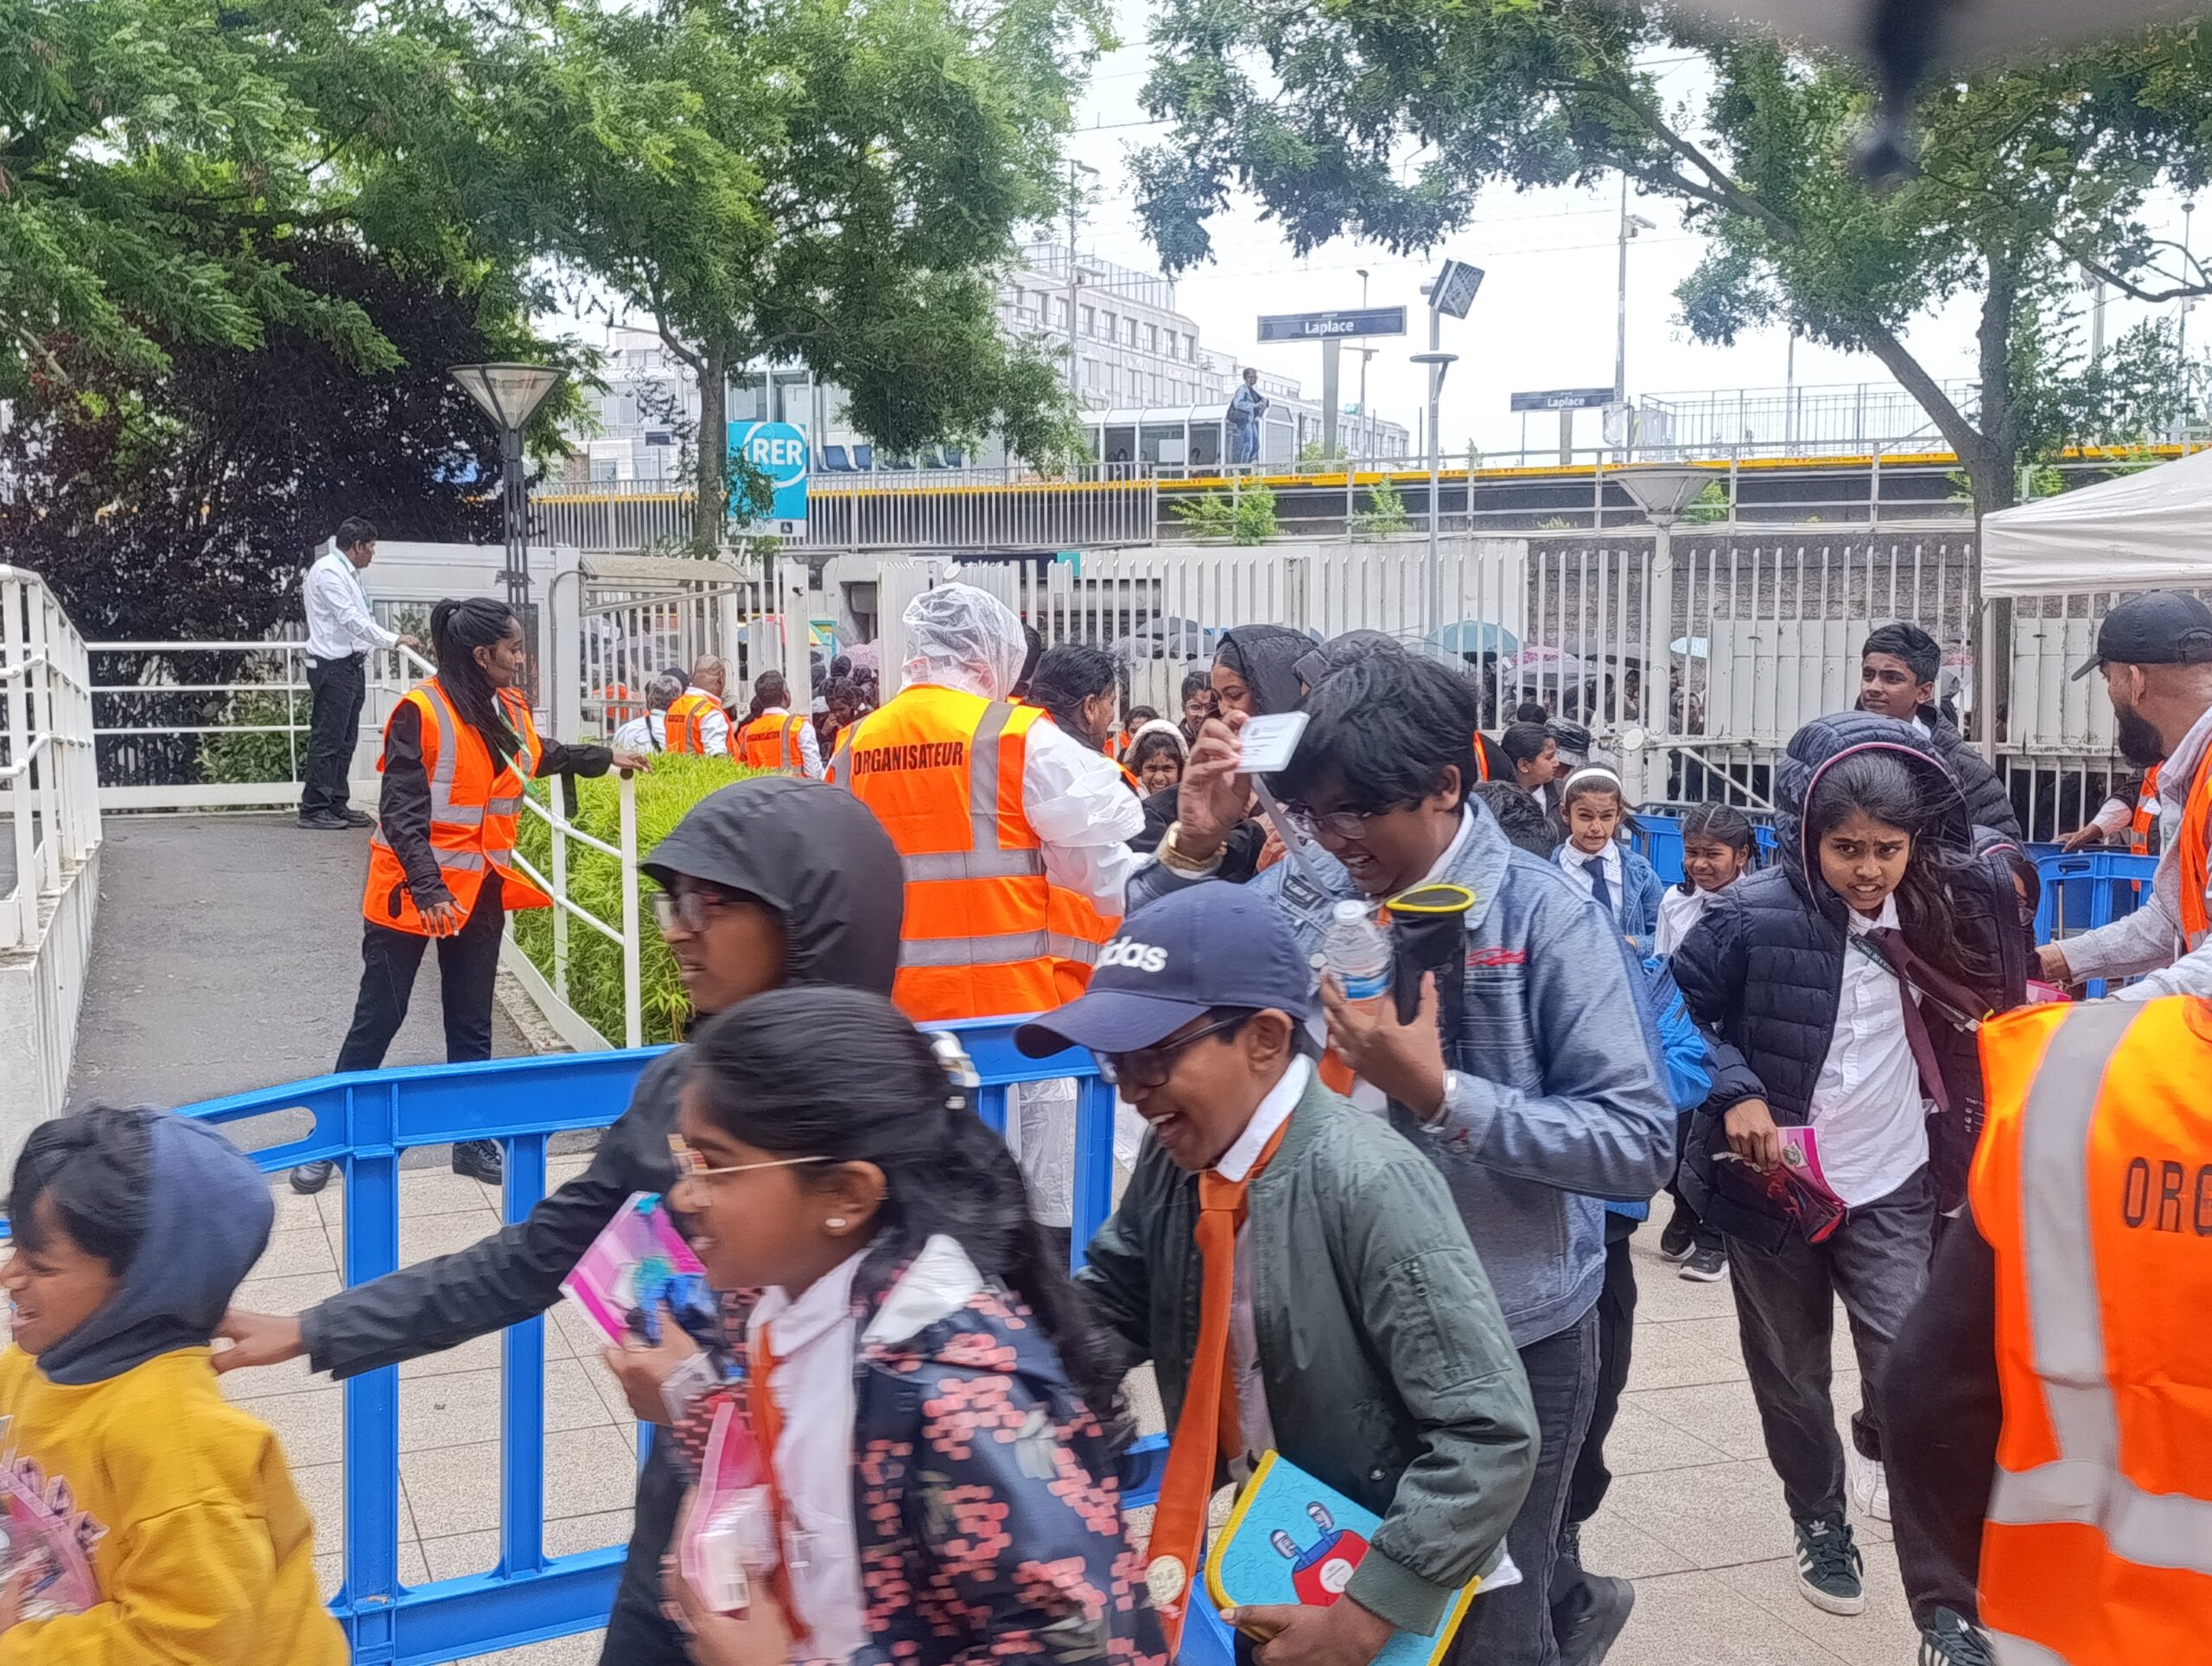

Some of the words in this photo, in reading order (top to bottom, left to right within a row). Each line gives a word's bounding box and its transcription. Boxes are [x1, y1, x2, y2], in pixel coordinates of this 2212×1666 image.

[1305, 320, 1354, 336] Laplace
[1547, 397, 1586, 409] Laplace
[753, 438, 803, 466] RER
[853, 741, 963, 776] ORGANISATEUR
